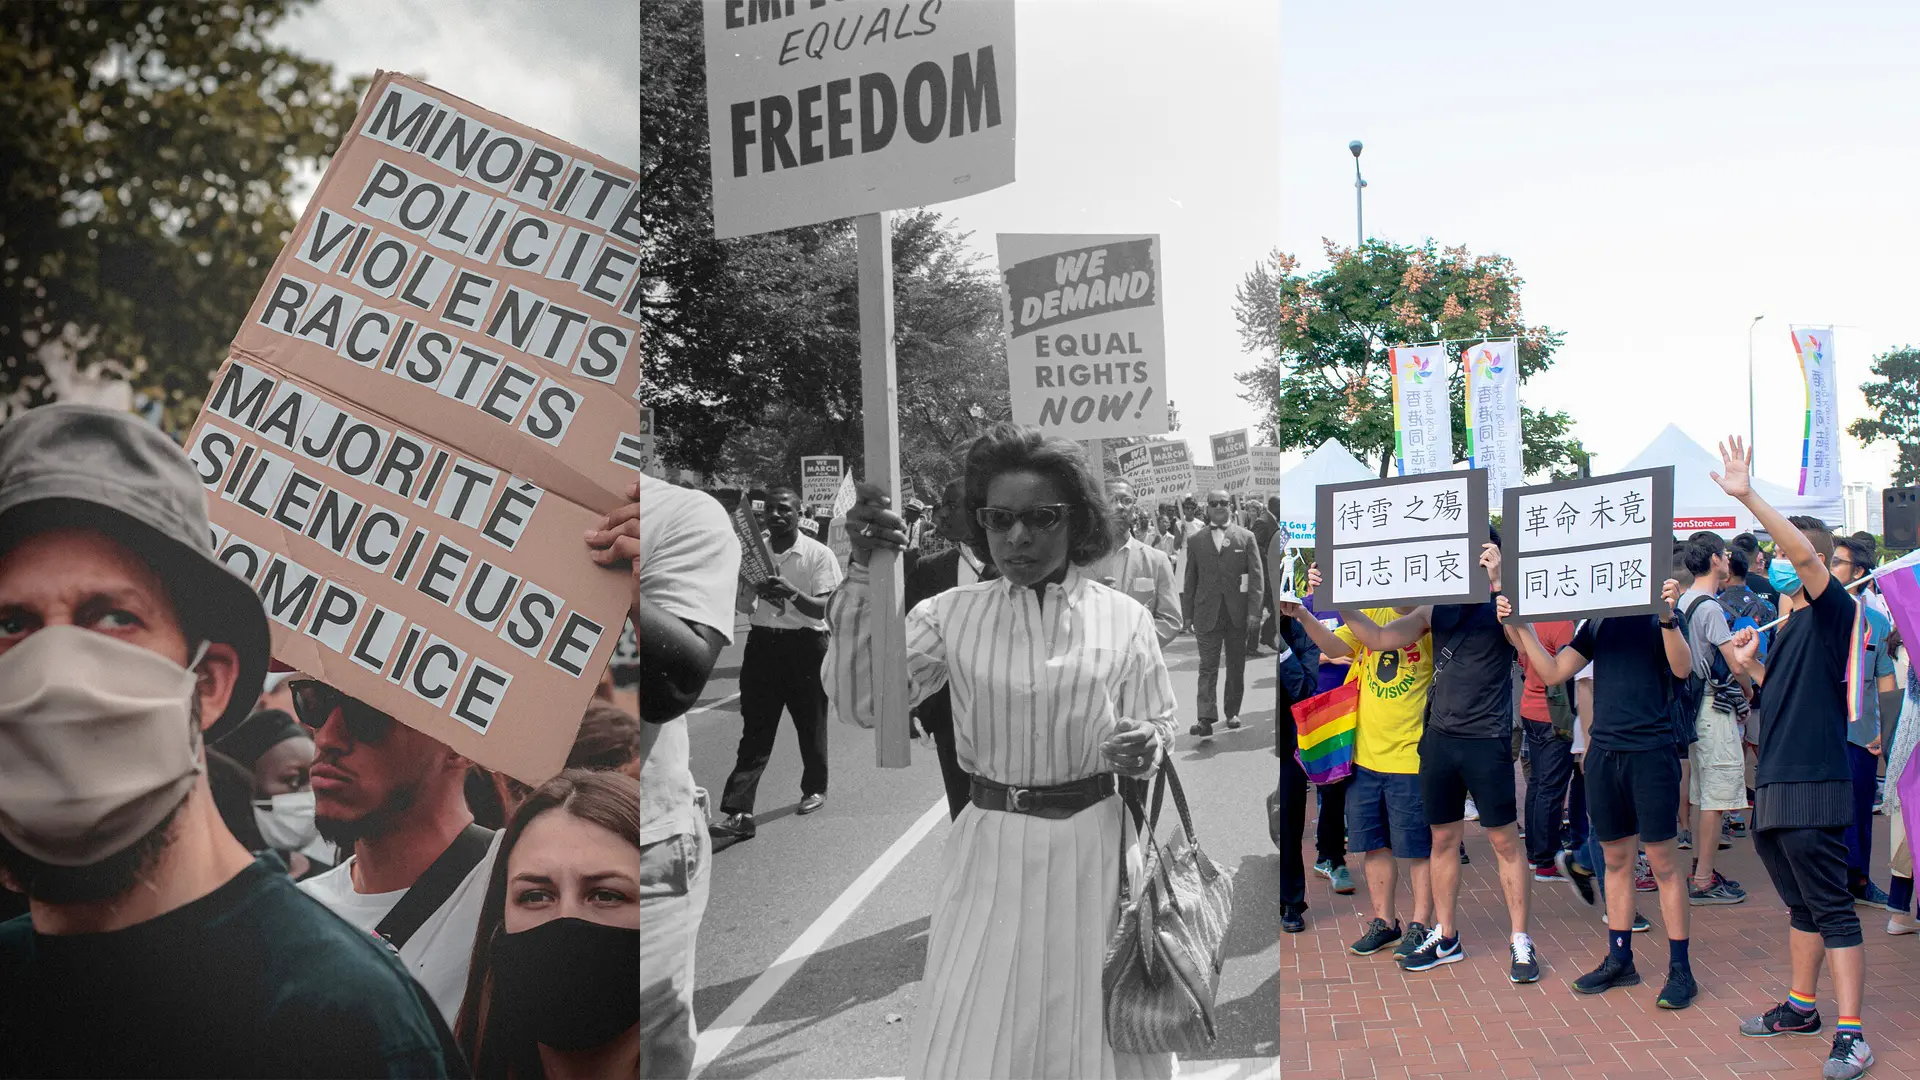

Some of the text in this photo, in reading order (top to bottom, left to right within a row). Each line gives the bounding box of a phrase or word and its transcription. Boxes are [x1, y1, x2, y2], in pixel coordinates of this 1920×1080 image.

[778, 0, 942, 66] EQUALS
[731, 44, 1001, 178] FREEDOM
[1055, 249, 1107, 285] WE
[308, 211, 627, 377] VIOLENTS
[1020, 270, 1150, 326] DEMAND
[261, 278, 575, 440] RACISTES
[1035, 332, 1142, 357] EQUAL
[1035, 361, 1148, 388] RIGHTS
[1038, 386, 1153, 427] NOW!
[212, 363, 536, 547] MAJORITÉ
[1131, 447, 1145, 460] WE
[1154, 450, 1185, 461] MARCH
[1216, 461, 1232, 471] FIRST
[1233, 458, 1250, 468] CLASS
[1217, 441, 1245, 455] MARCH
[1153, 464, 1190, 476] INTEGRATED
[1155, 472, 1192, 484] SCHOOLS
[1161, 480, 1192, 495] NOW!
[1216, 465, 1251, 479] CITIZENSHIP
[1289, 521, 1307, 531] Gay
[1525, 490, 1646, 537] 革命未竟
[191, 433, 603, 675] SILENCIEUSE
[1339, 550, 1464, 588] 同志同哀
[1525, 558, 1646, 599] 同志同路
[209, 528, 506, 729] OMPLICE
